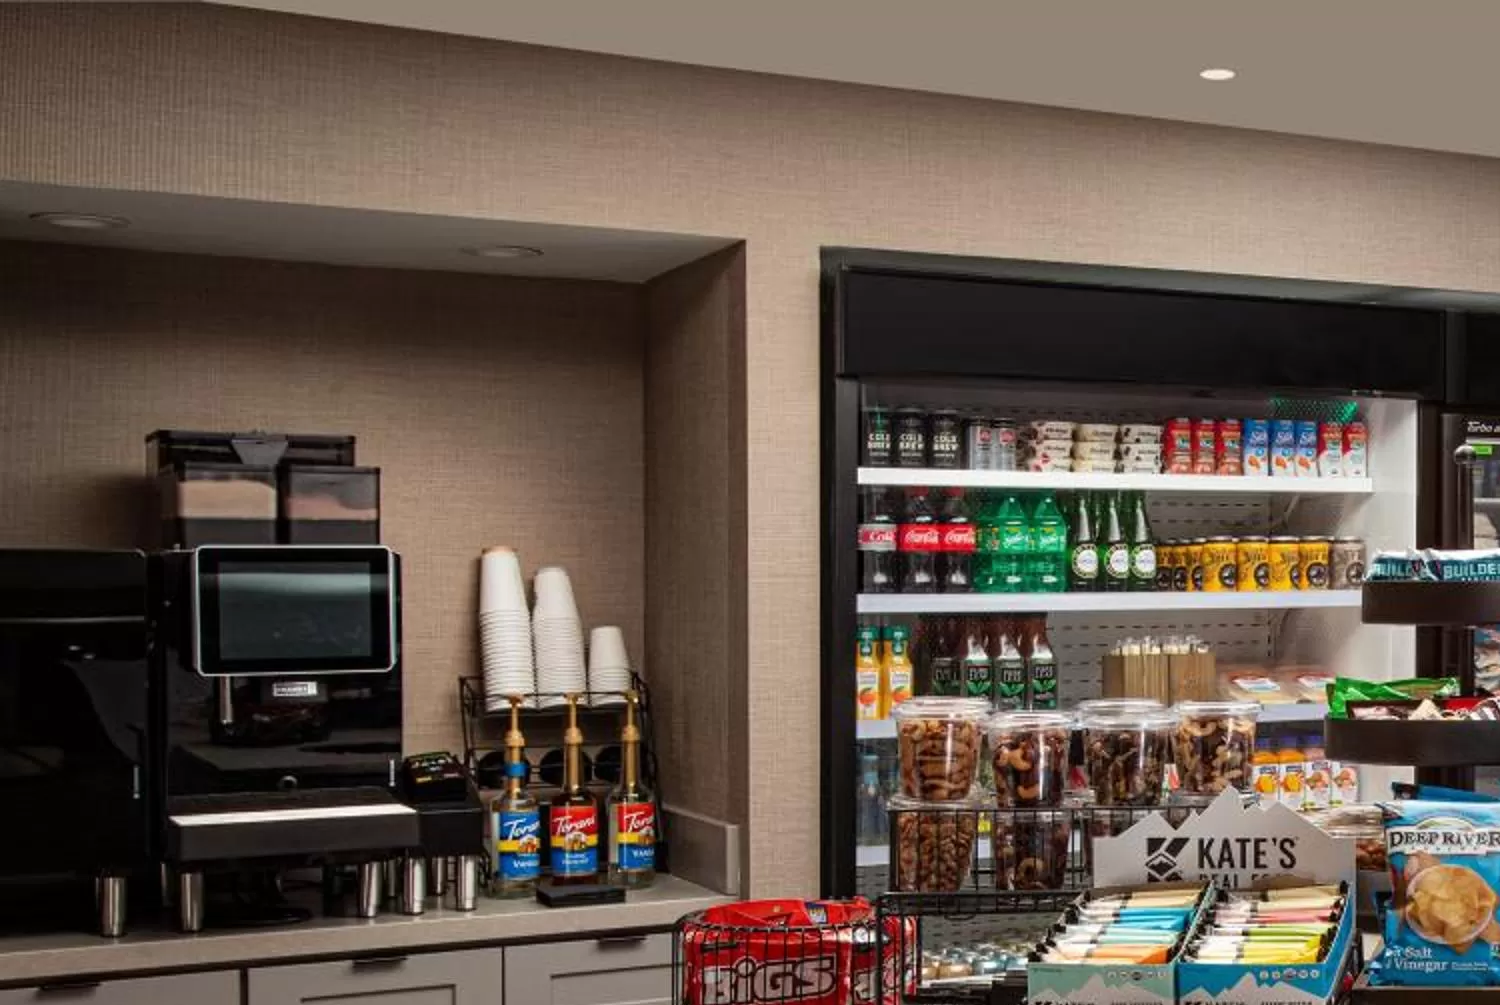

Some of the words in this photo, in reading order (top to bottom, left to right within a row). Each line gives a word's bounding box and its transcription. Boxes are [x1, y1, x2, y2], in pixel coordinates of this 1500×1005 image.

[1467, 421, 1493, 433] Turbo
[1390, 830, 1439, 847] DEEP
[1198, 837, 1296, 869] KATE'S
[1404, 946, 1433, 958] Salt
[1393, 958, 1449, 973] Vinegar
